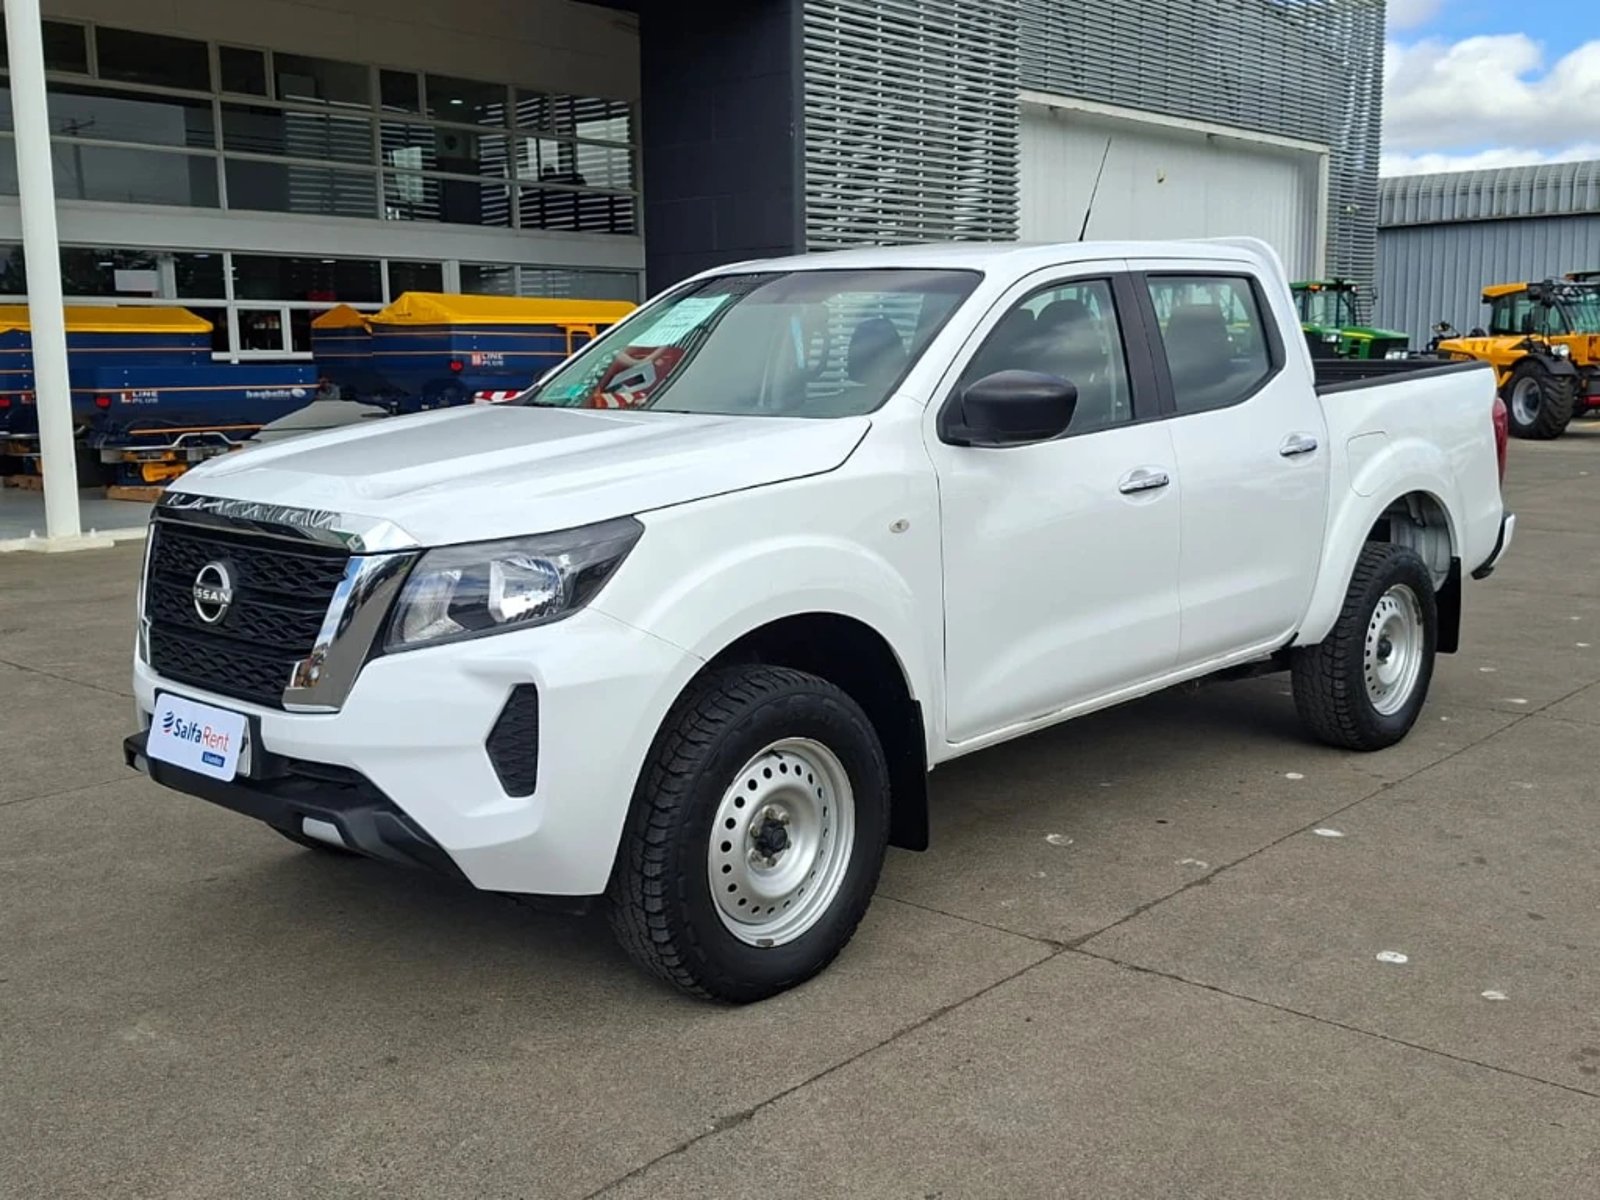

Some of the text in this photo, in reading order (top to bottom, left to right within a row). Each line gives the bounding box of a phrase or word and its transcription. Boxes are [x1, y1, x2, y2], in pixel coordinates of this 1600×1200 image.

[132, 389, 158, 397] LINE
[193, 586, 231, 602] SSAN
[173, 718, 230, 752] SalfaRent
